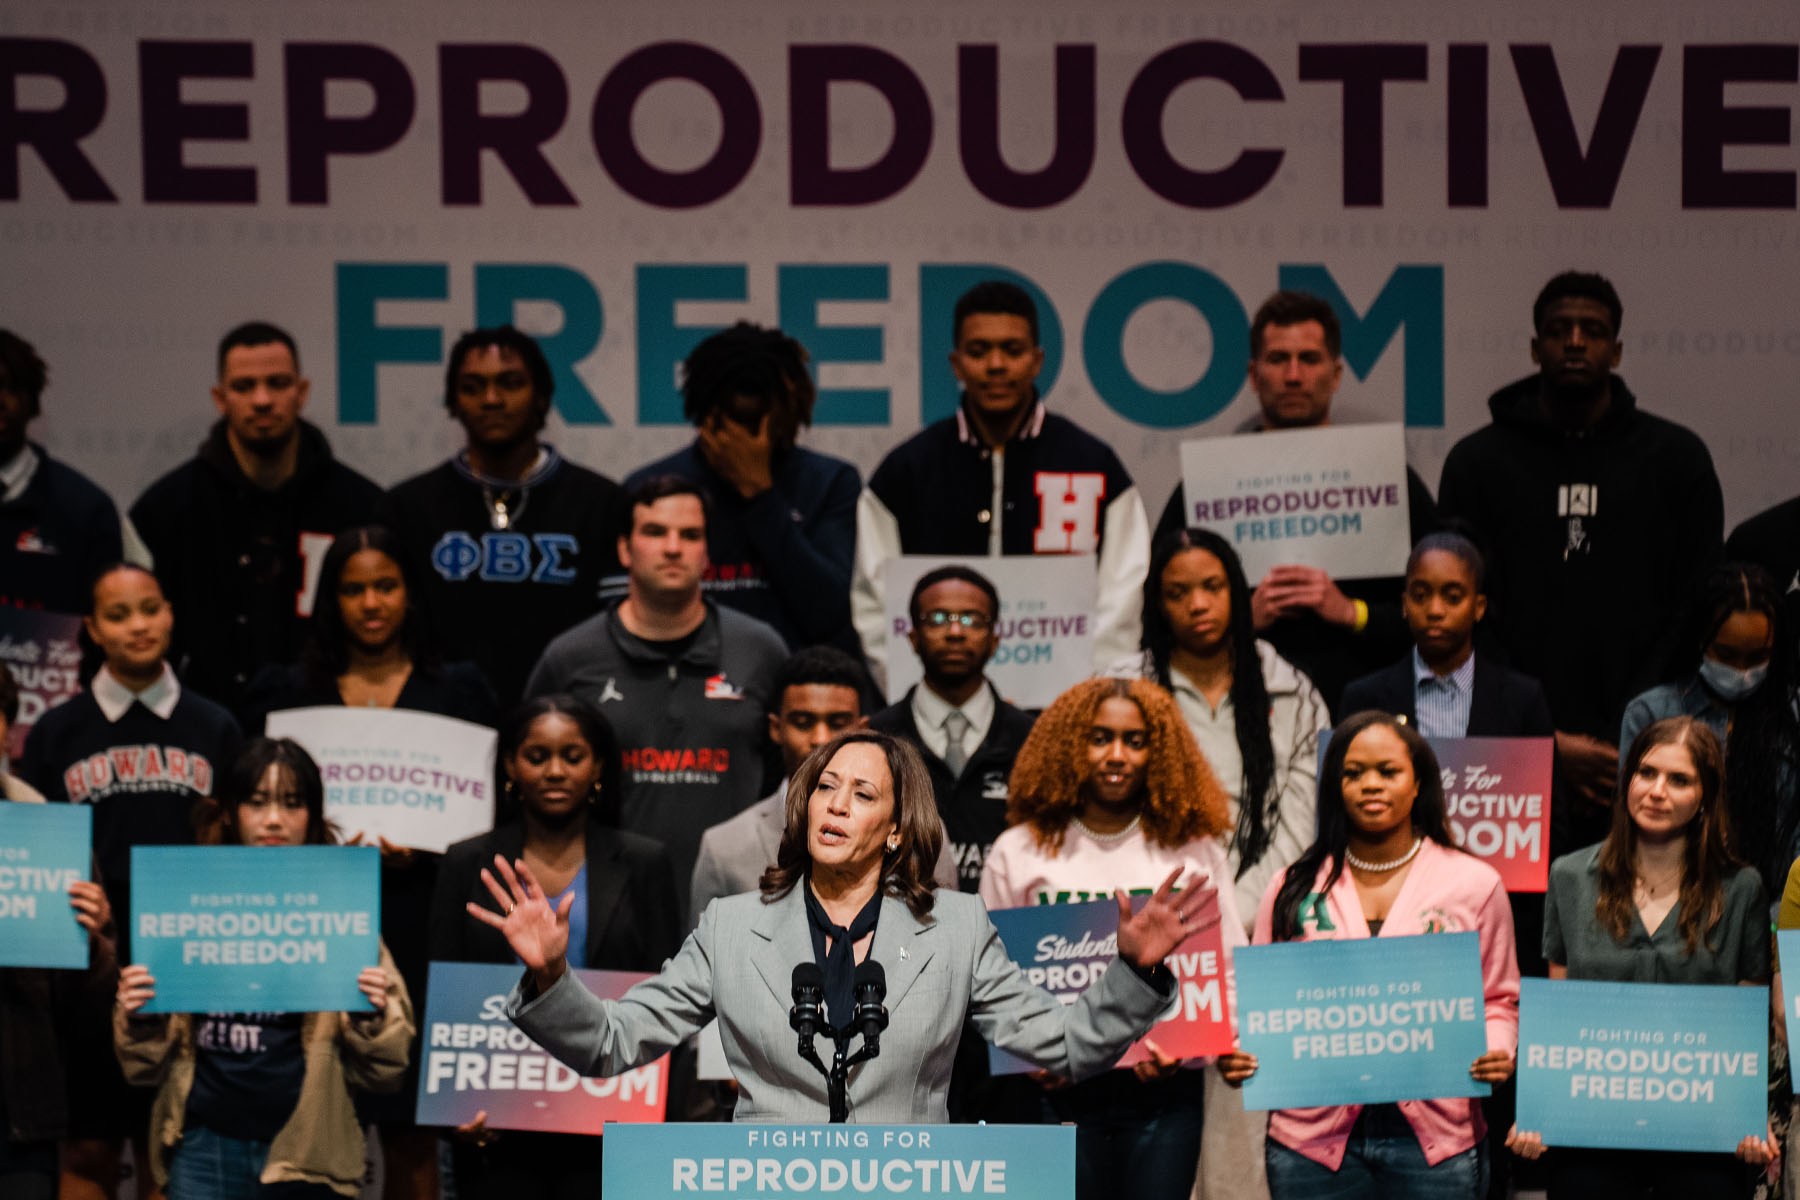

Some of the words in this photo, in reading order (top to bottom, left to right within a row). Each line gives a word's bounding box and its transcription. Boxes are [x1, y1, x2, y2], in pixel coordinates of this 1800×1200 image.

[0, 38, 1800, 211] REPRODUCTIVE
[1033, 470, 1106, 555] H
[1195, 484, 1399, 521] REPRODUCTIVE
[1235, 513, 1362, 543] FREEDOM
[63, 743, 214, 804] HOWARD
[620, 746, 730, 773] HOWARD
[318, 763, 485, 800] RODUCTIVE
[1464, 764, 1502, 791] For
[326, 787, 446, 812] REEDOM
[190, 893, 275, 908] FIGHTING
[283, 892, 319, 907] FOR
[139, 911, 371, 938] REPRODUCTIVE
[182, 940, 327, 965] FREEDOM
[1296, 984, 1380, 1001] FIGHTING
[1387, 981, 1422, 995] FOR
[1247, 996, 1476, 1035] REPRODUCTIVE
[1292, 1027, 1435, 1060] FREEDOM
[1579, 1028, 1665, 1043] FIGHTING
[1673, 1032, 1708, 1045] FOR
[1527, 1043, 1759, 1077] REPRODUCTIVE
[1570, 1074, 1715, 1103] FREEDOM
[748, 1131, 869, 1147] FIGHTING
[883, 1131, 931, 1148] FOR
[672, 1157, 1007, 1194] REPRODUCTIVE
